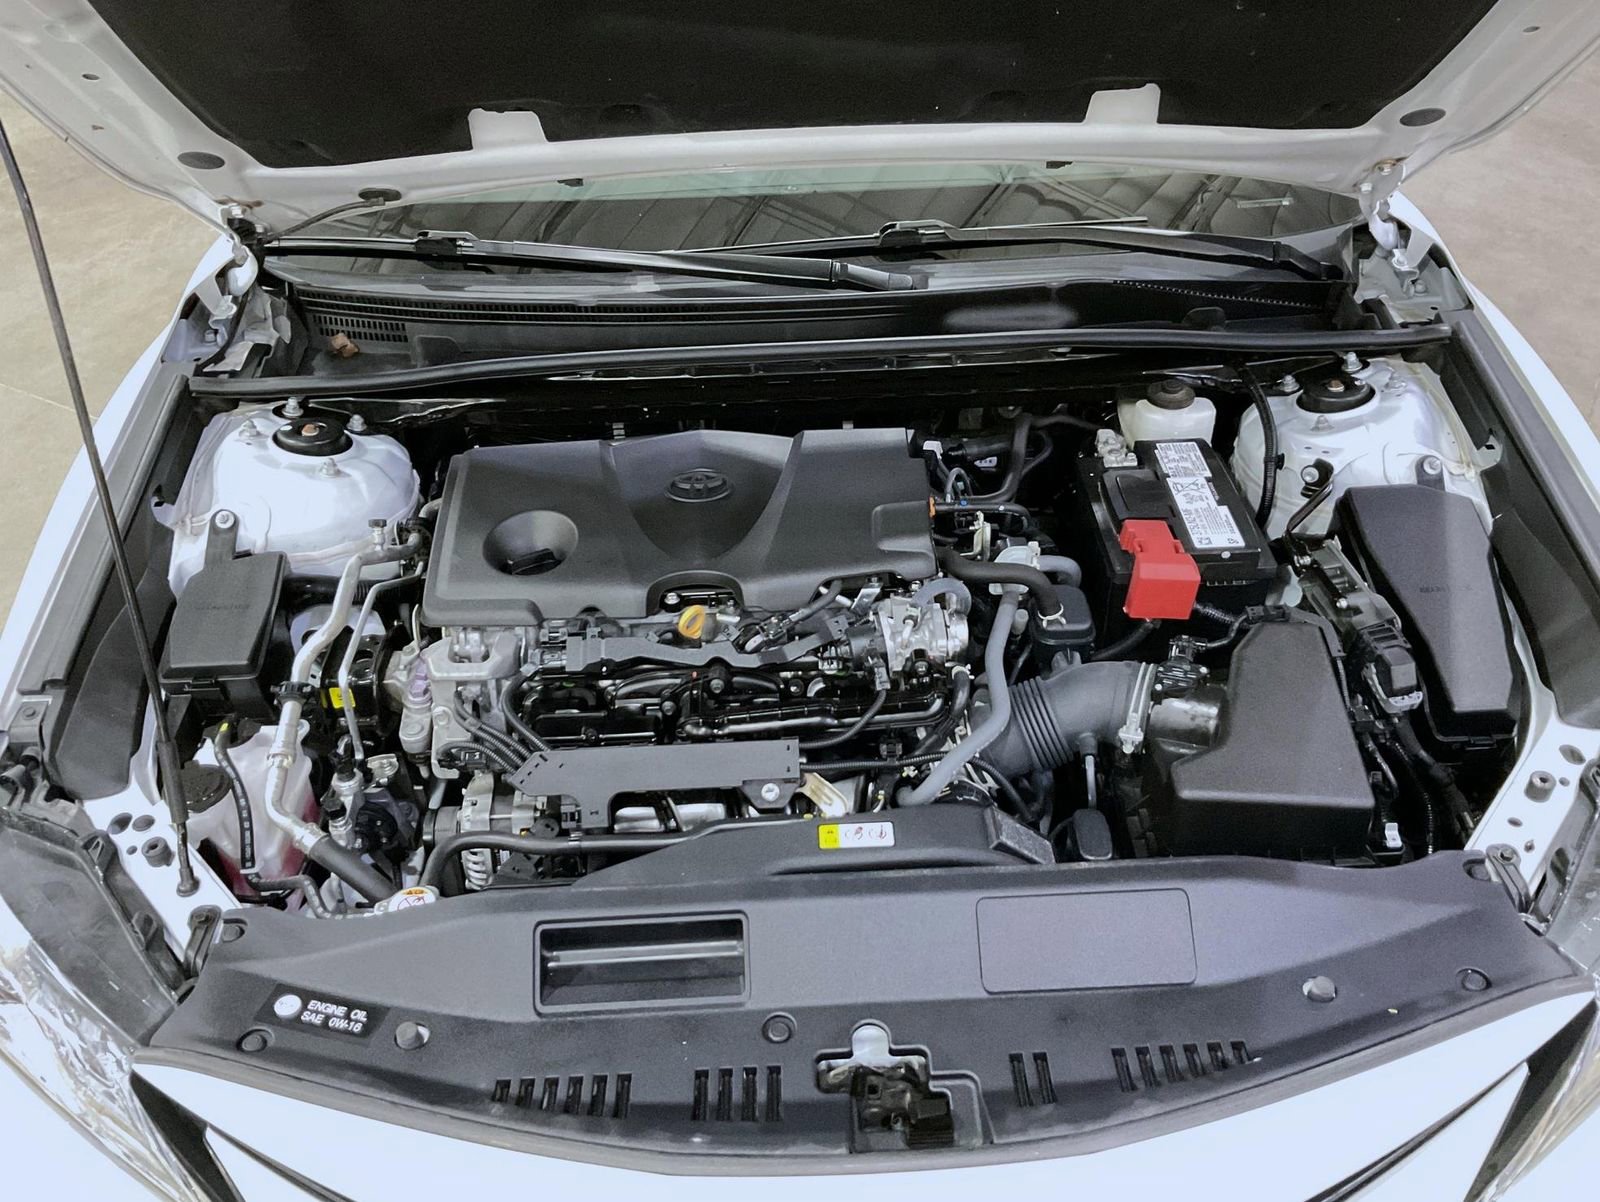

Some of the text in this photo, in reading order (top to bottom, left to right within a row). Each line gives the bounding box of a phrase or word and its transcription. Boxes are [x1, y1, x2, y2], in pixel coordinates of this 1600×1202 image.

[301, 1011, 362, 1033] SAE 0W-16
[307, 1000, 368, 1022] ENGINE OIL
